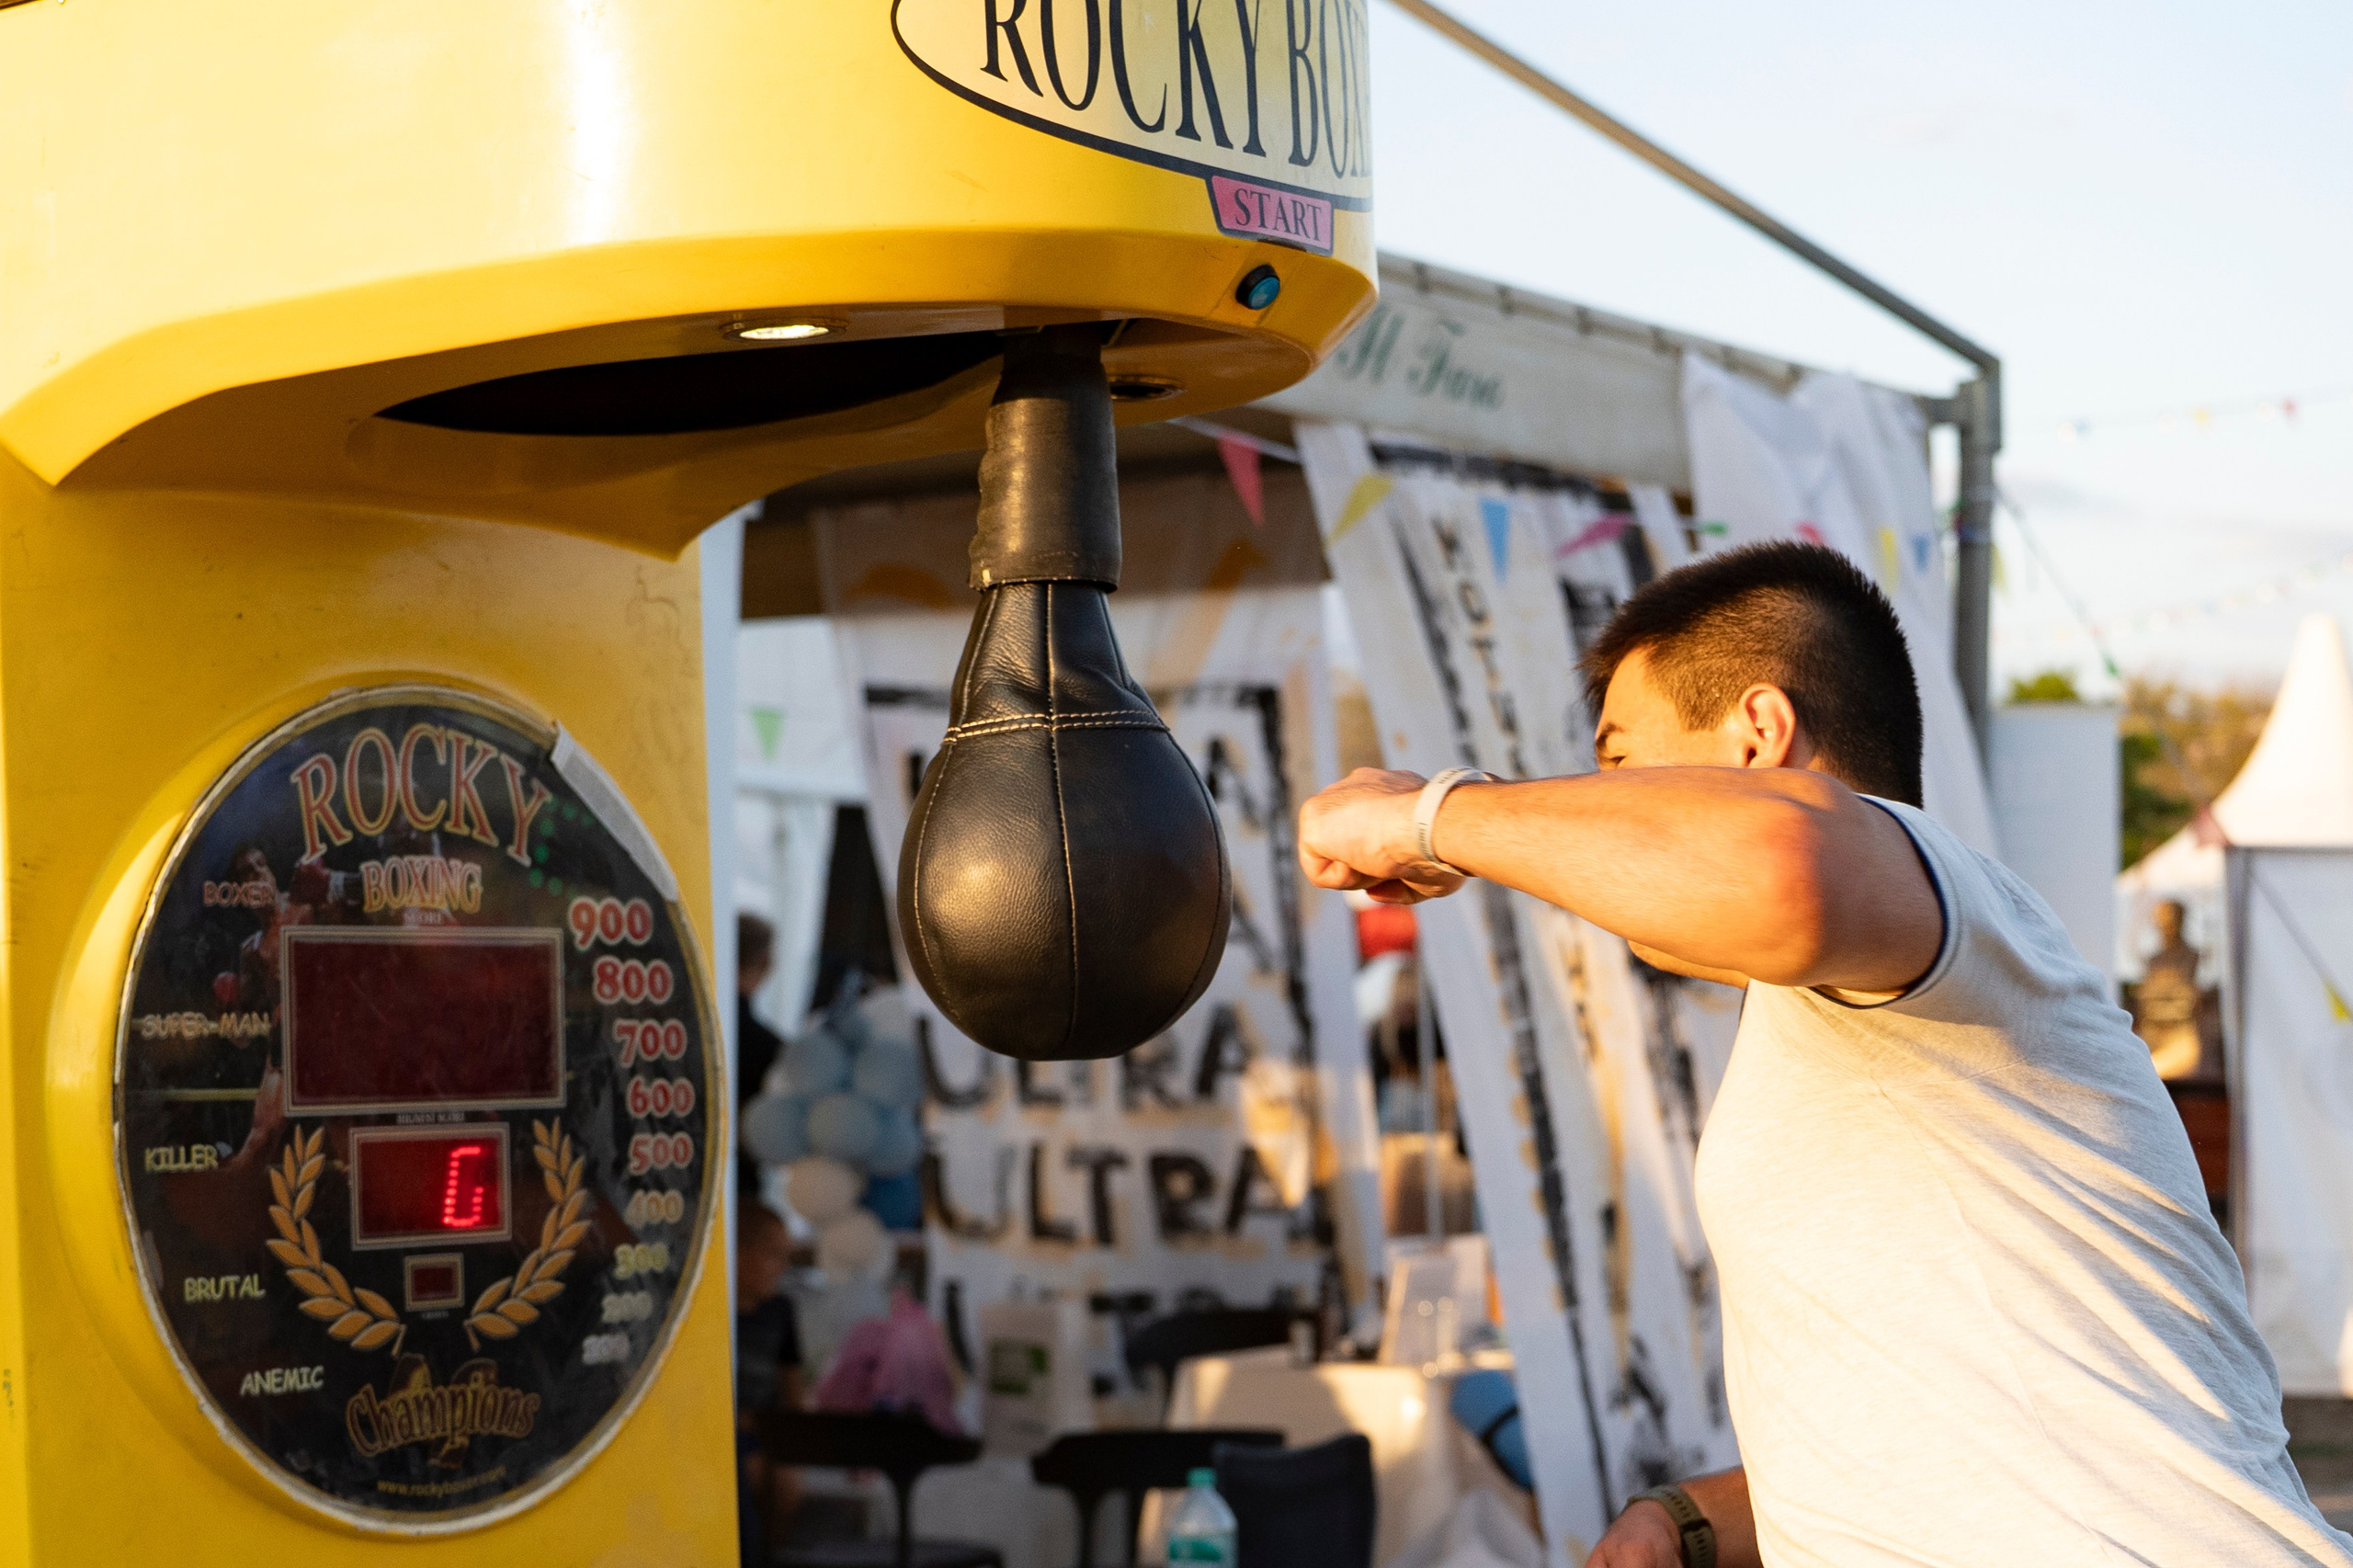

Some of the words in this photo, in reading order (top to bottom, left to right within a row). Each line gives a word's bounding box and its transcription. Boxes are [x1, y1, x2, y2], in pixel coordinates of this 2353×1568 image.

[1233, 187, 1323, 243] START
[290, 723, 552, 868] ROCKY
[202, 880, 275, 908] BOXER
[358, 854, 483, 914] BOXING
[568, 897, 654, 951] 900
[593, 955, 675, 1005] 800
[612, 1018, 687, 1068] 700
[626, 1074, 696, 1119] 600
[144, 1143, 219, 1174] KILLER
[628, 1131, 694, 1176] 500
[623, 1188, 684, 1229] 400
[921, 1138, 1320, 1246] ULTRA
[613, 1243, 669, 1280] 300
[185, 1273, 266, 1303] BRUTAL
[239, 1365, 324, 1396] ANEMIC
[346, 1383, 540, 1457] Champions
